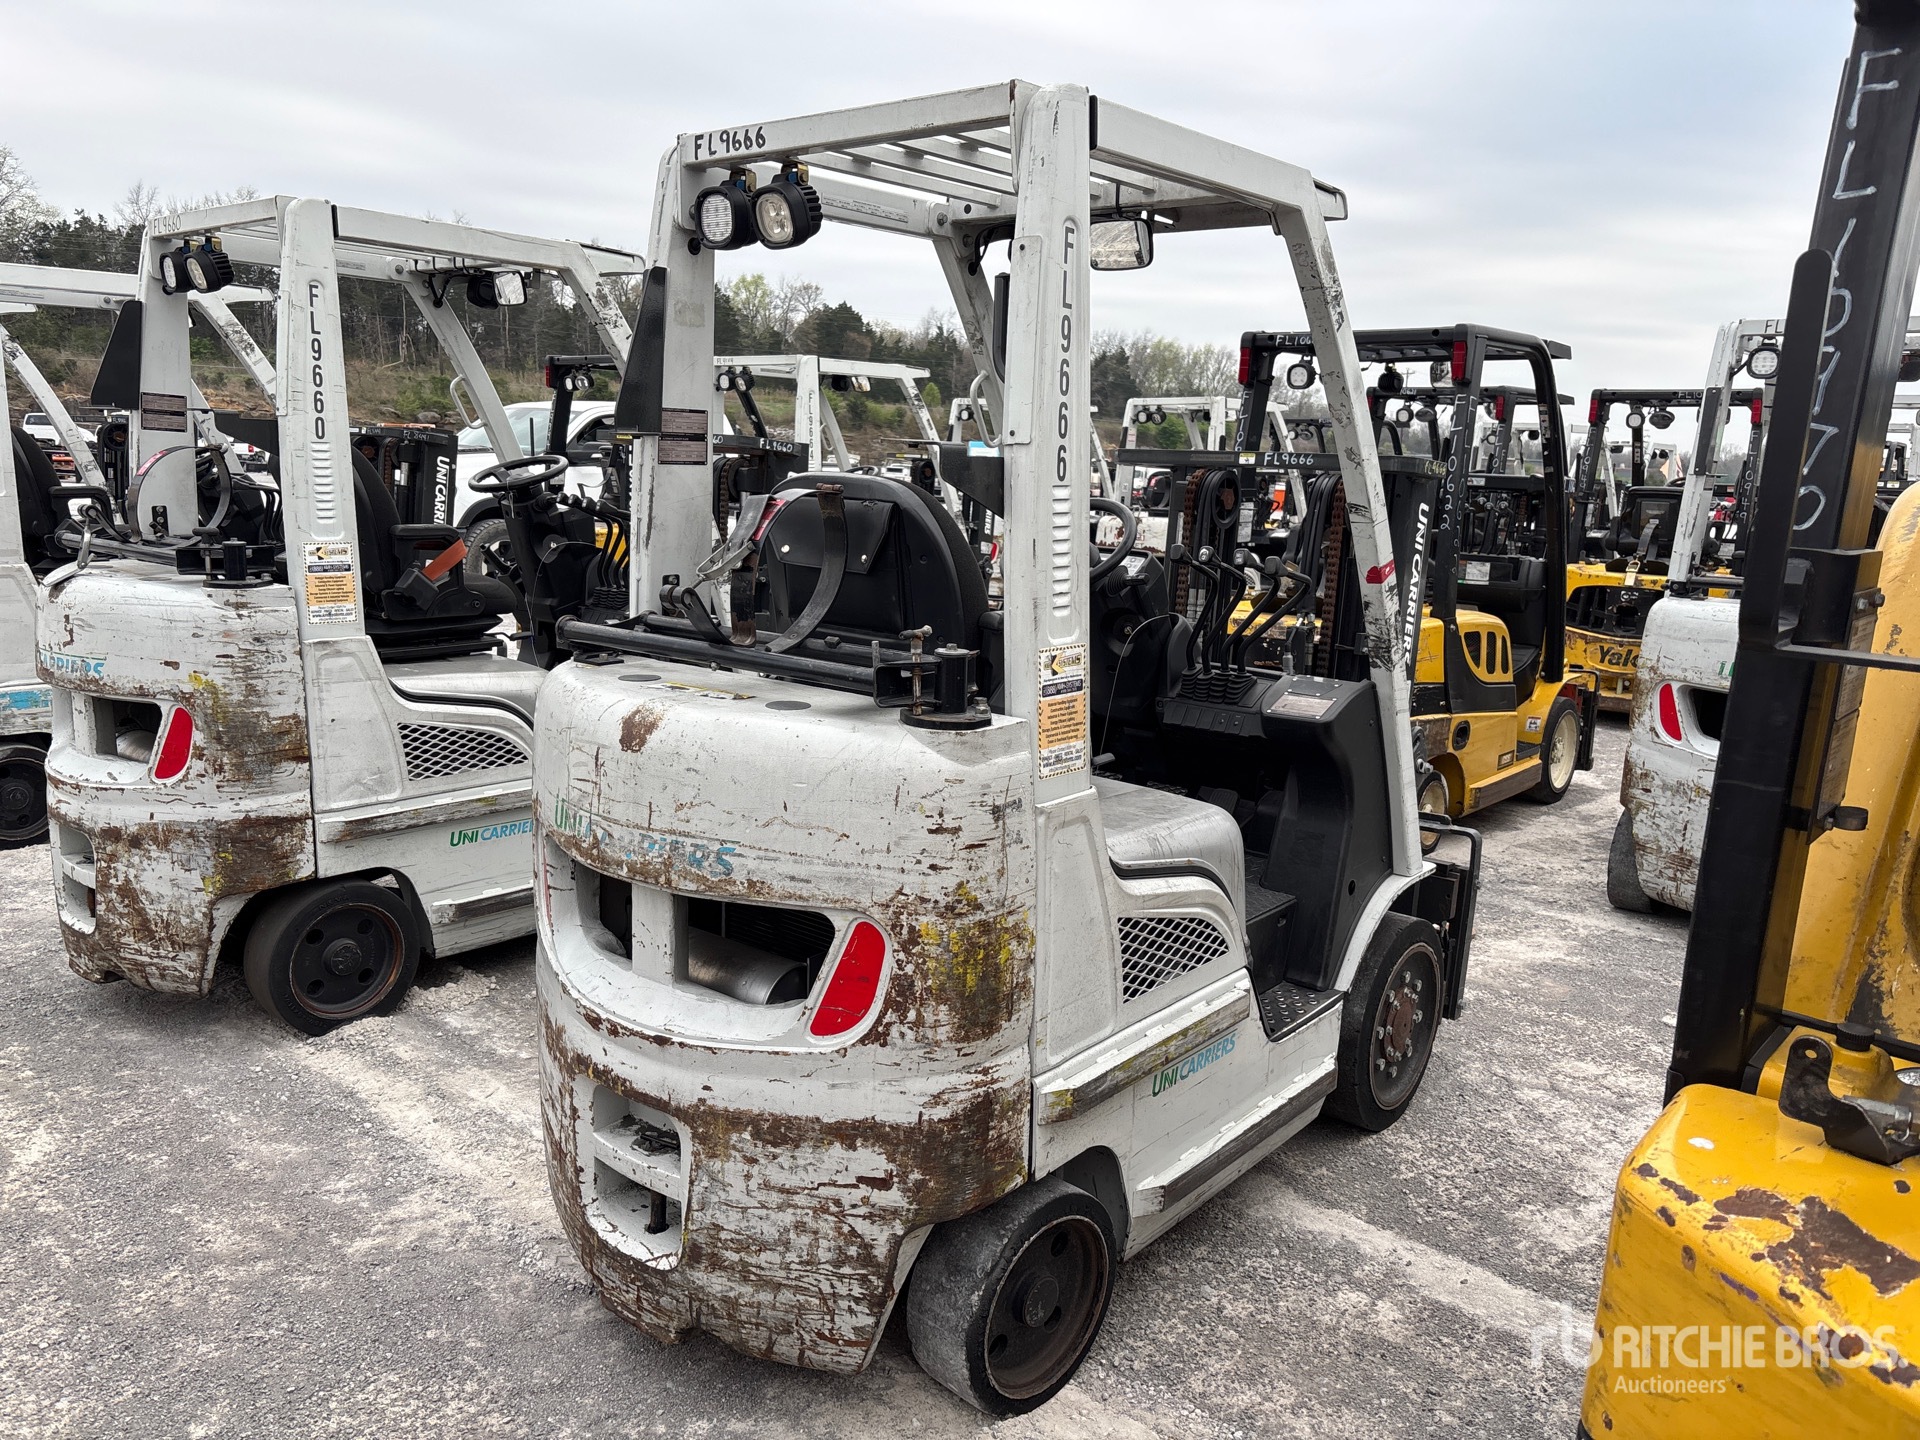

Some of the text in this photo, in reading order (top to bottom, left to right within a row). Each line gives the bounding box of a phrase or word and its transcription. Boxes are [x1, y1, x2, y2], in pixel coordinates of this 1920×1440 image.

[694, 126, 766, 160] FL9666
[153, 214, 181, 234] FL9660
[308, 284, 325, 439] FL9660
[1056, 226, 1075, 482] FL9666
[759, 438, 793, 453] FL9660
[1263, 453, 1314, 466] FL9666
[1440, 394, 1467, 531] FL10622
[1739, 430, 1760, 524] FL10949
[1403, 502, 1430, 666] UNICARRIERS
[1152, 1032, 1236, 1097] UNICARRIERS
